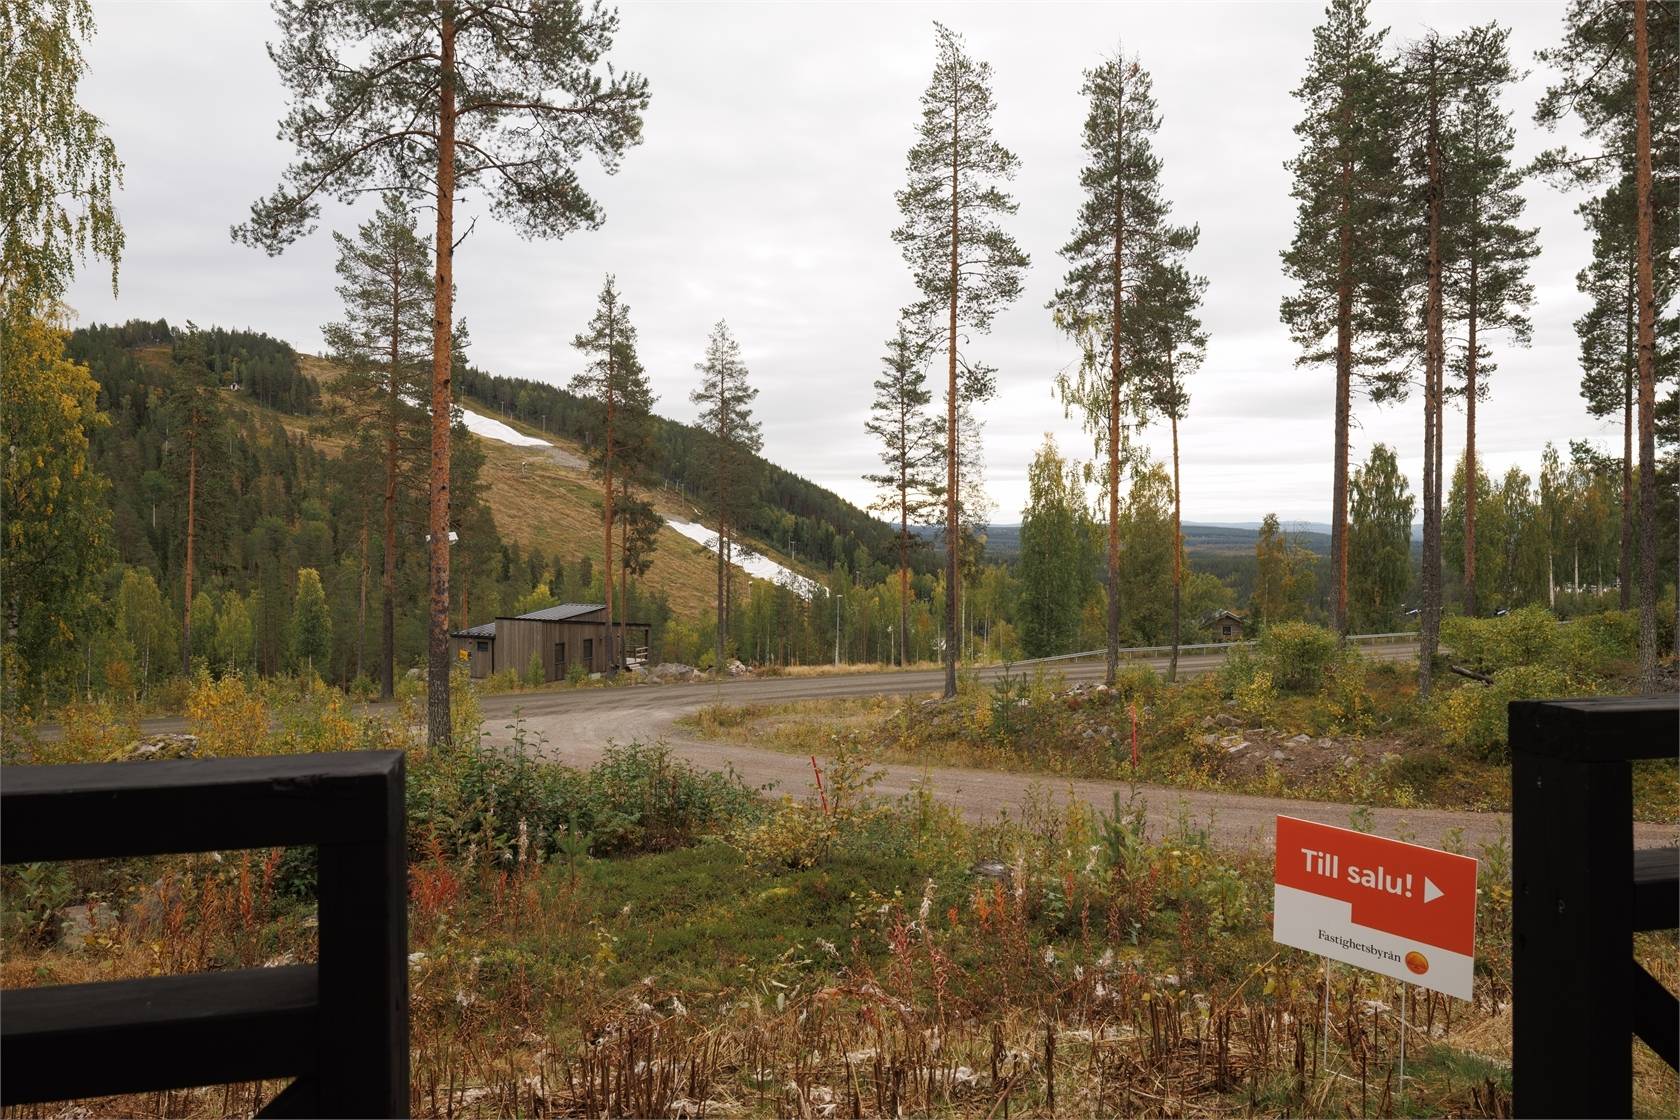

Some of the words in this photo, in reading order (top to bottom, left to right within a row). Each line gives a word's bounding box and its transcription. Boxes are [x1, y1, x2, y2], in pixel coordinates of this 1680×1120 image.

[1301, 848, 1339, 878] Till
[1347, 866, 1413, 898] salu!
[1318, 929, 1401, 963] Fastighetsbyrån
